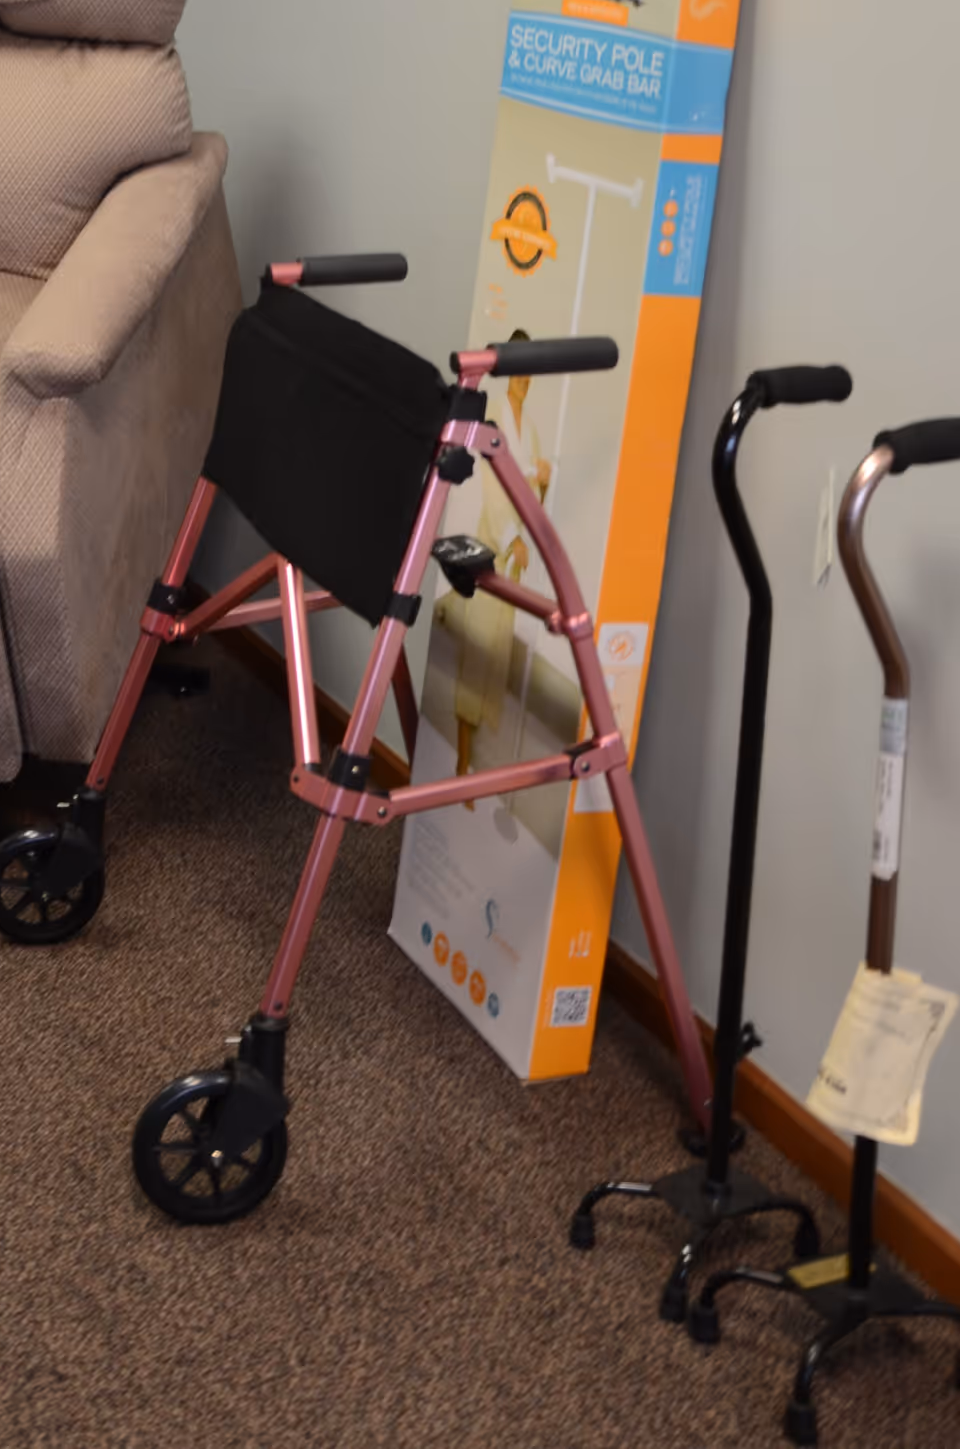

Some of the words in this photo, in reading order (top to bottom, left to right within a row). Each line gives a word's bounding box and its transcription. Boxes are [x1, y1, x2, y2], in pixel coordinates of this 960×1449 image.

[508, 50, 521, 69] &
[523, 53, 577, 81] CURVE
[580, 65, 624, 91] GRAB
[627, 76, 661, 100] BAR
[510, 25, 608, 62] SECURITY
[612, 45, 664, 76] POLE
